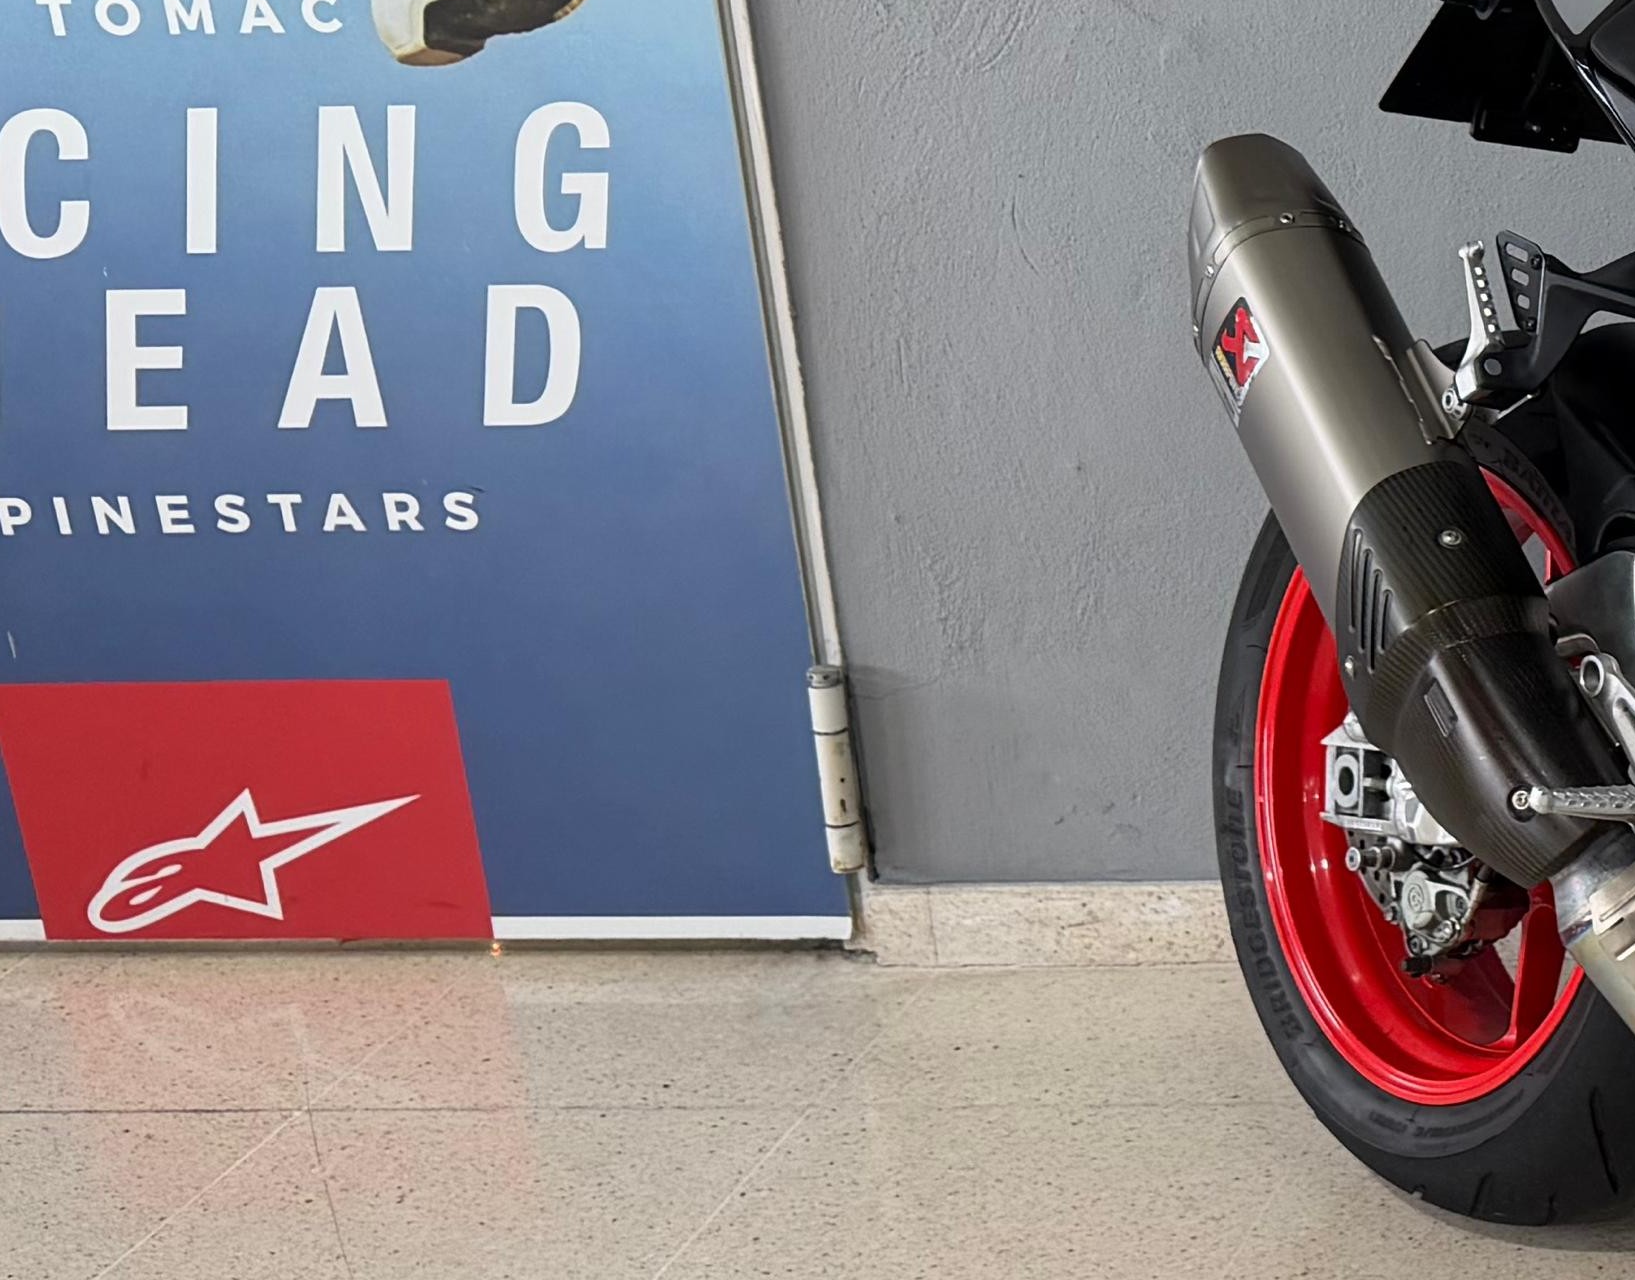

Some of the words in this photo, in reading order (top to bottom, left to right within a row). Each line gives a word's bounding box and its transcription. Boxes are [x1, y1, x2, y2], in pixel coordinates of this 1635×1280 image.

[0, 100, 612, 259] CING
[106, 283, 583, 431] EAD
[0, 490, 483, 538] PINESTARS
